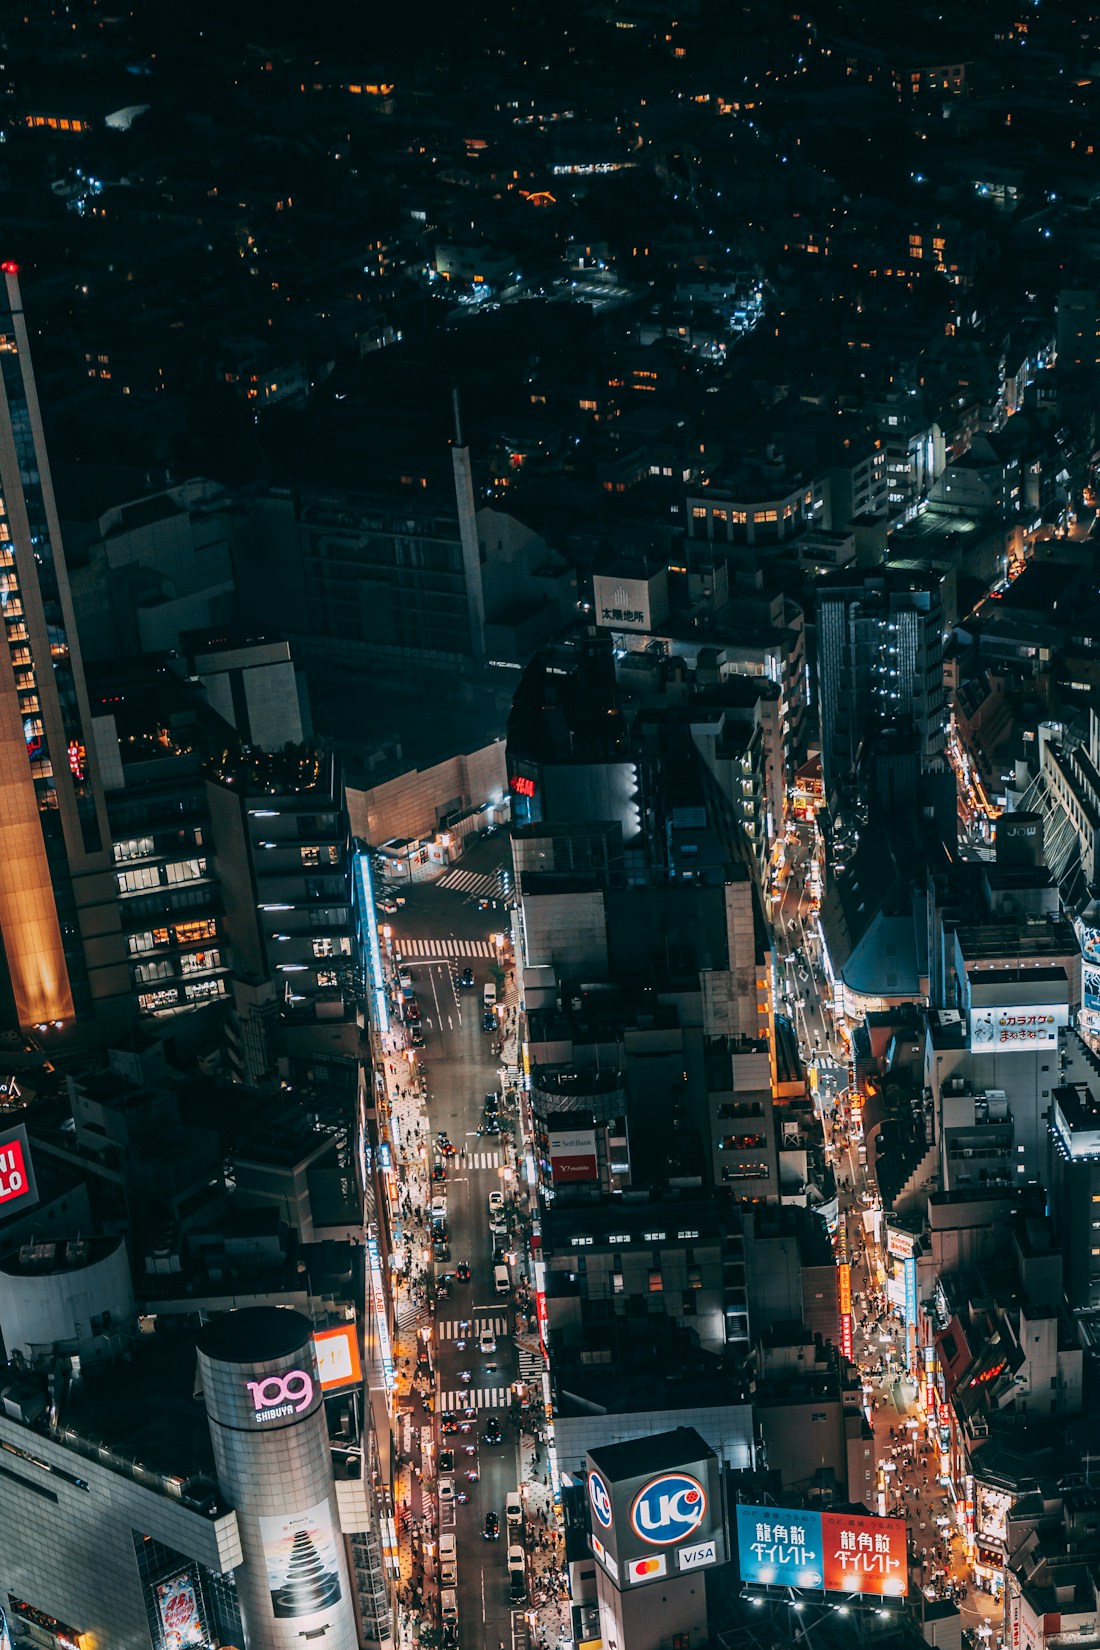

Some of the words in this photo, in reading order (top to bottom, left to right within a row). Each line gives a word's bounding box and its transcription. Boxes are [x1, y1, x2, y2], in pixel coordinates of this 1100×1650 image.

[602, 607, 644, 623] 太陽地所
[1006, 1015, 1047, 1026] カラオケ
[999, 1028, 1047, 1042] まねきねこ
[562, 1138, 592, 1148] SoftBank
[246, 1370, 314, 1413] 109
[255, 1405, 294, 1423] SHIBUYA
[639, 1488, 702, 1530] UC
[755, 1522, 806, 1546] 龍角散
[839, 1530, 891, 1554] 龍角散
[684, 1547, 714, 1564] VISA
[750, 1542, 816, 1566] ダイレクト
[833, 1550, 901, 1574] ダイレクト
